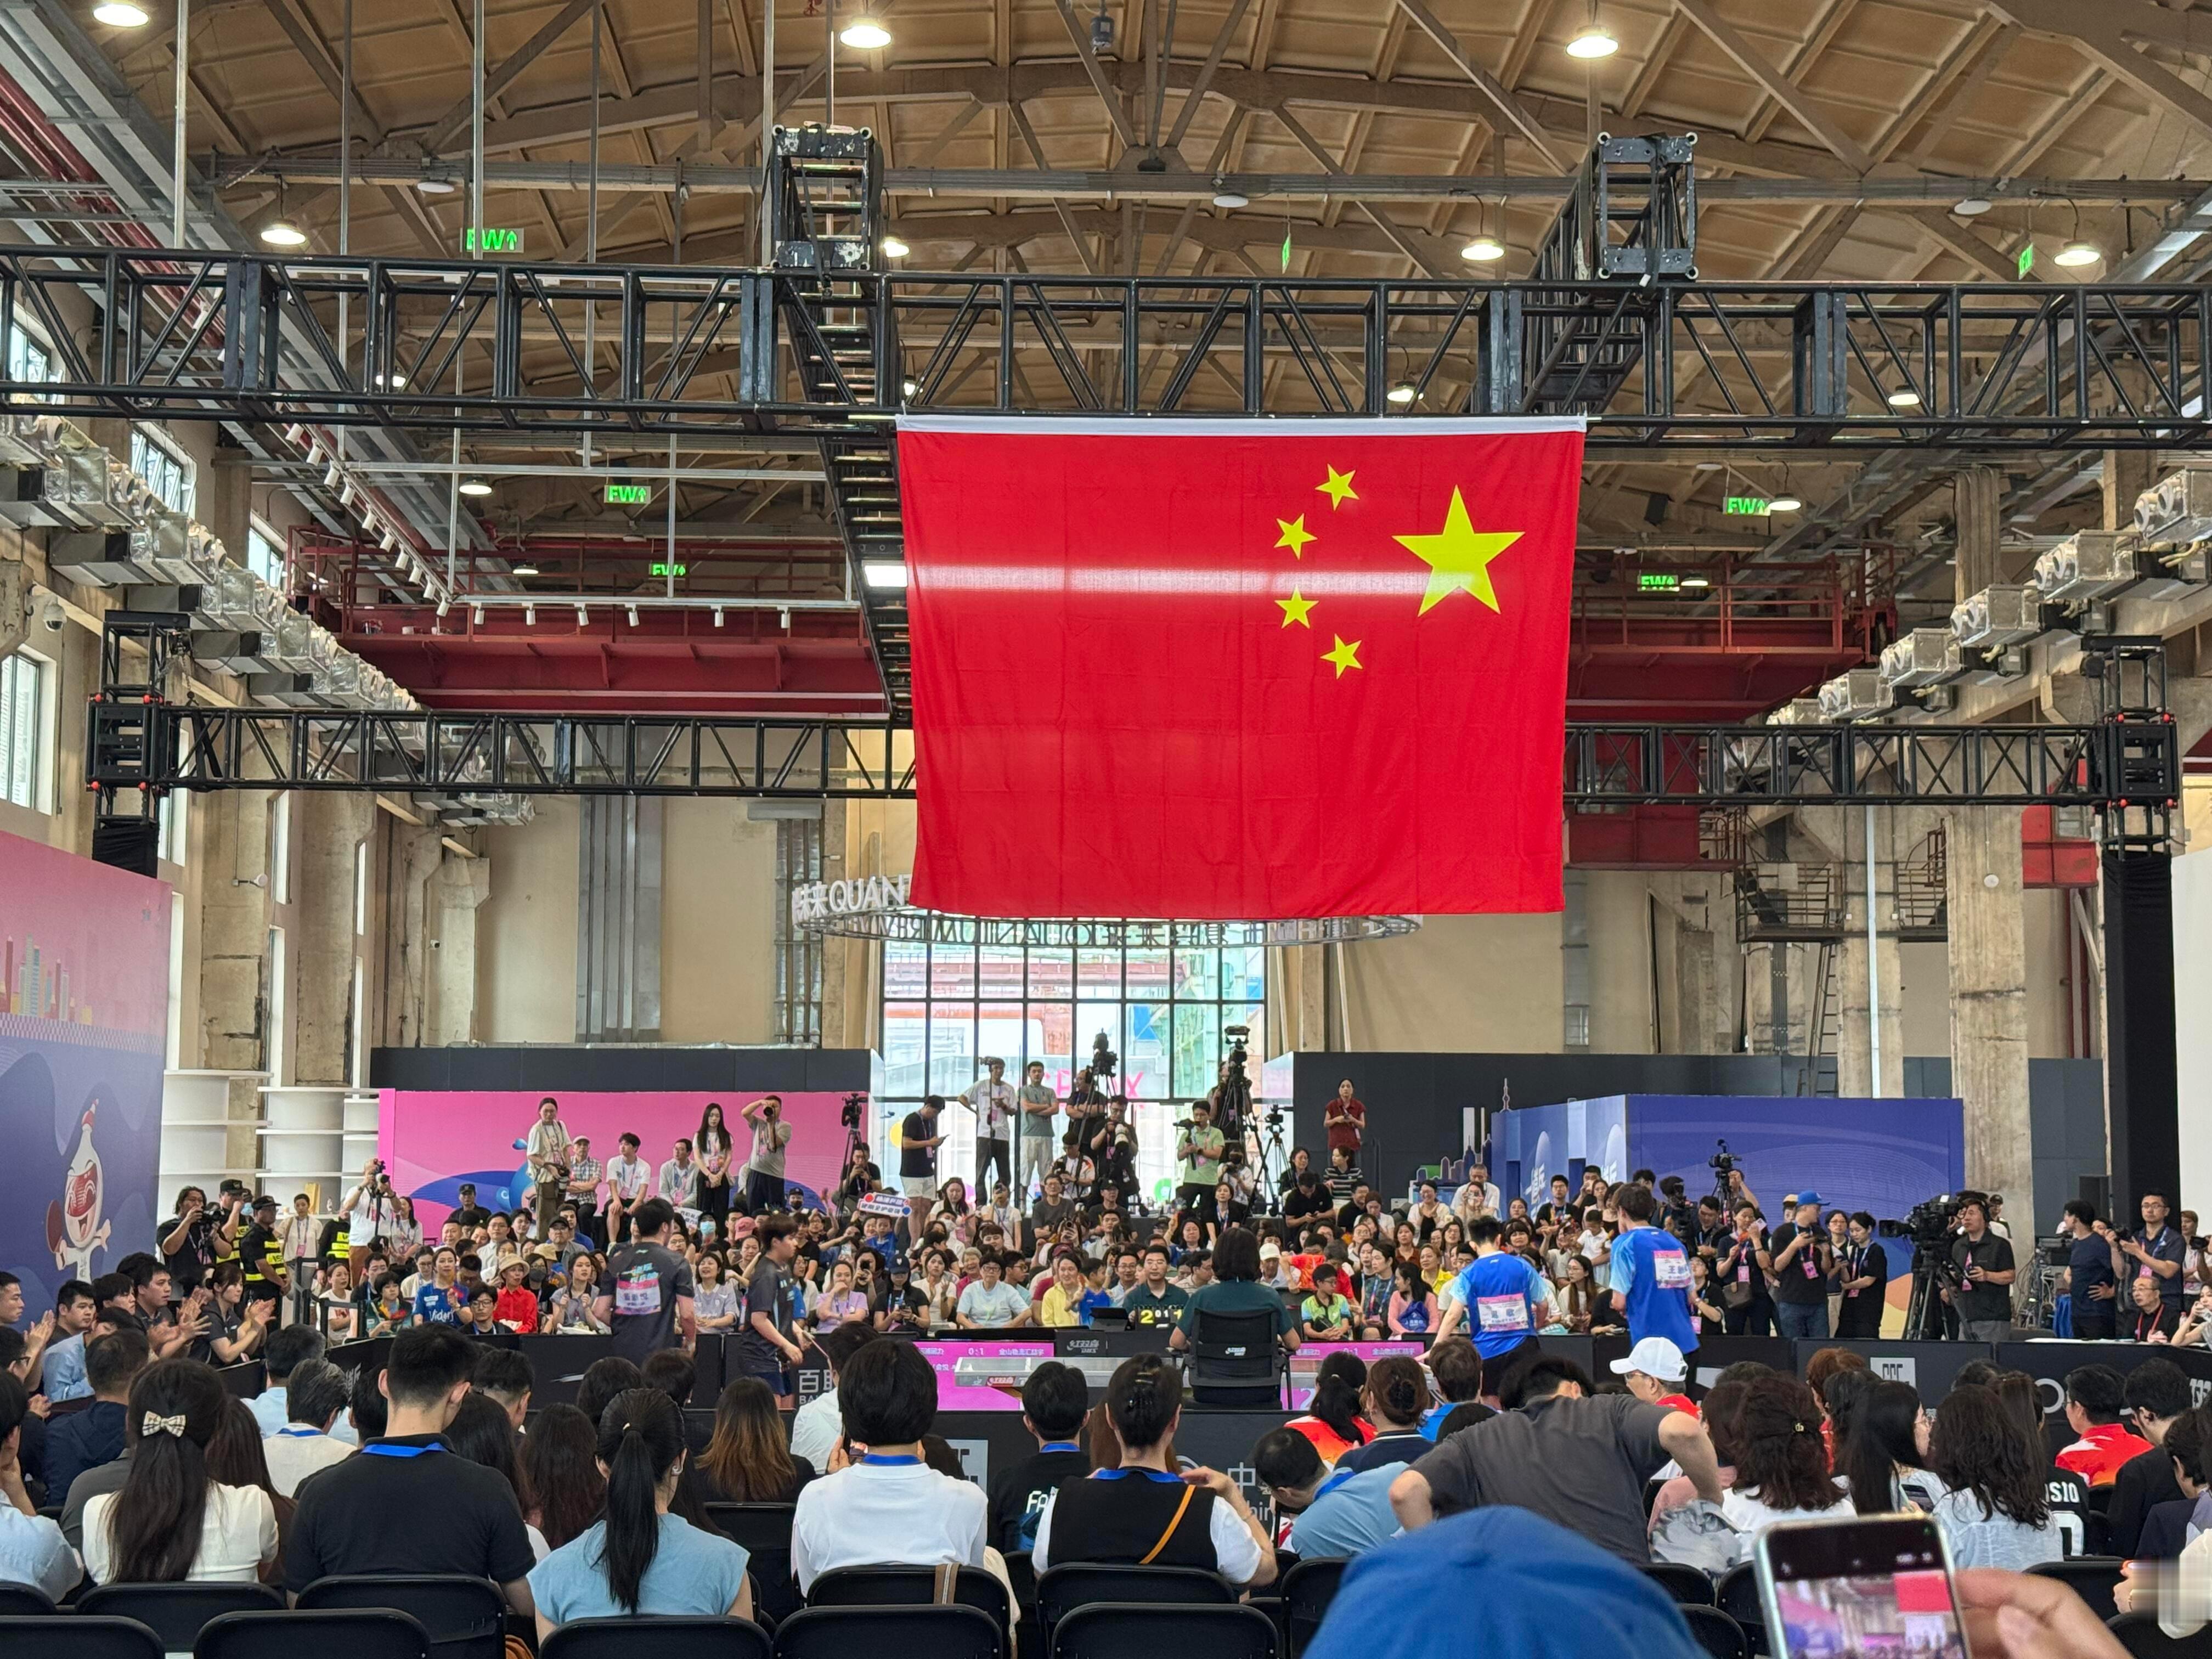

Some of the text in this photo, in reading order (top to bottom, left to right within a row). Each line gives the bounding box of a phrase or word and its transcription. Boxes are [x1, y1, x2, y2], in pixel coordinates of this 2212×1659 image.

[608, 486, 637, 501] FW
[829, 874, 905, 912] QUAN
[1140, 1309, 1154, 1324] 2
[1025, 1490, 1048, 1514] FA
